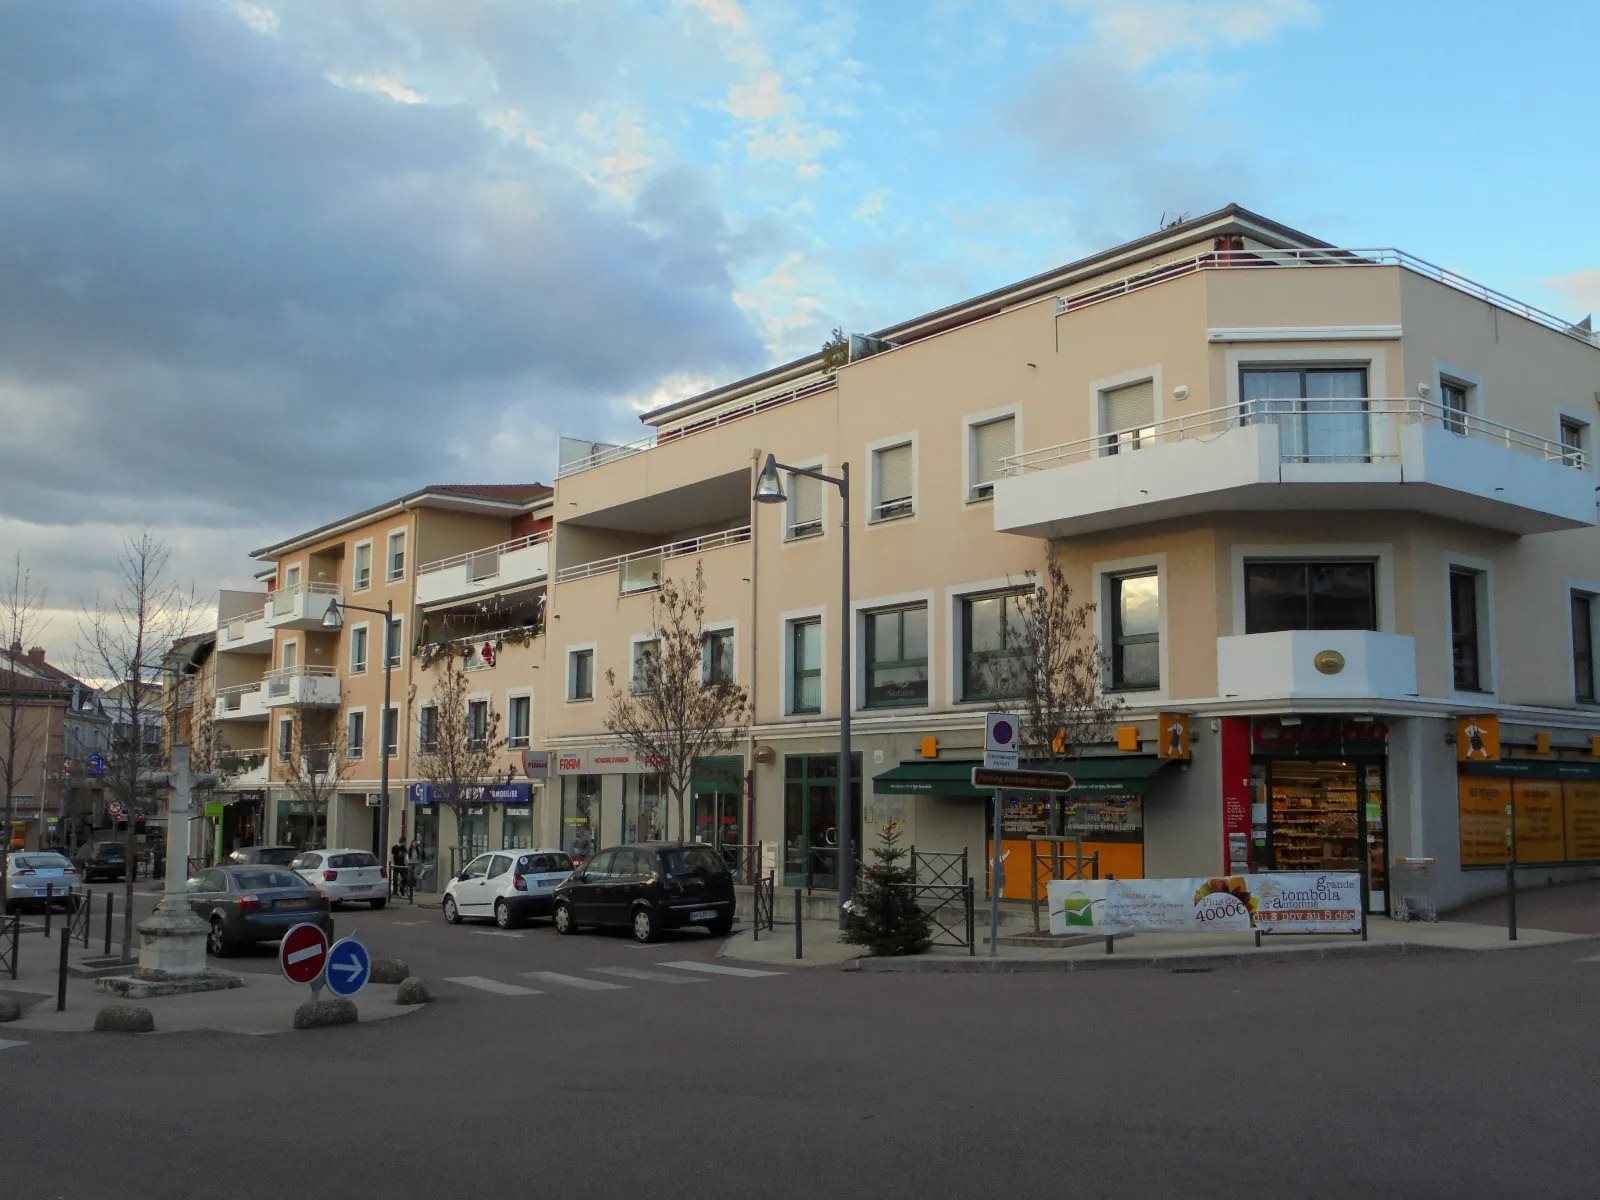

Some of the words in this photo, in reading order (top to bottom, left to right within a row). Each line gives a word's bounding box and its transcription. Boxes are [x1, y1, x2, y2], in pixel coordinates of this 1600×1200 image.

[559, 758, 580, 770] FRAM
[1316, 876, 1355, 892] grande
[1282, 889, 1341, 901] tombola
[1202, 898, 1224, 907] Plus
[1225, 897, 1238, 905] de
[1264, 898, 1319, 909] d'automne
[1195, 902, 1246, 922] 4000€
[1252, 911, 1269, 922] du
[1271, 912, 1278, 921] 3
[1282, 912, 1303, 920] nov
[1306, 911, 1321, 920] au
